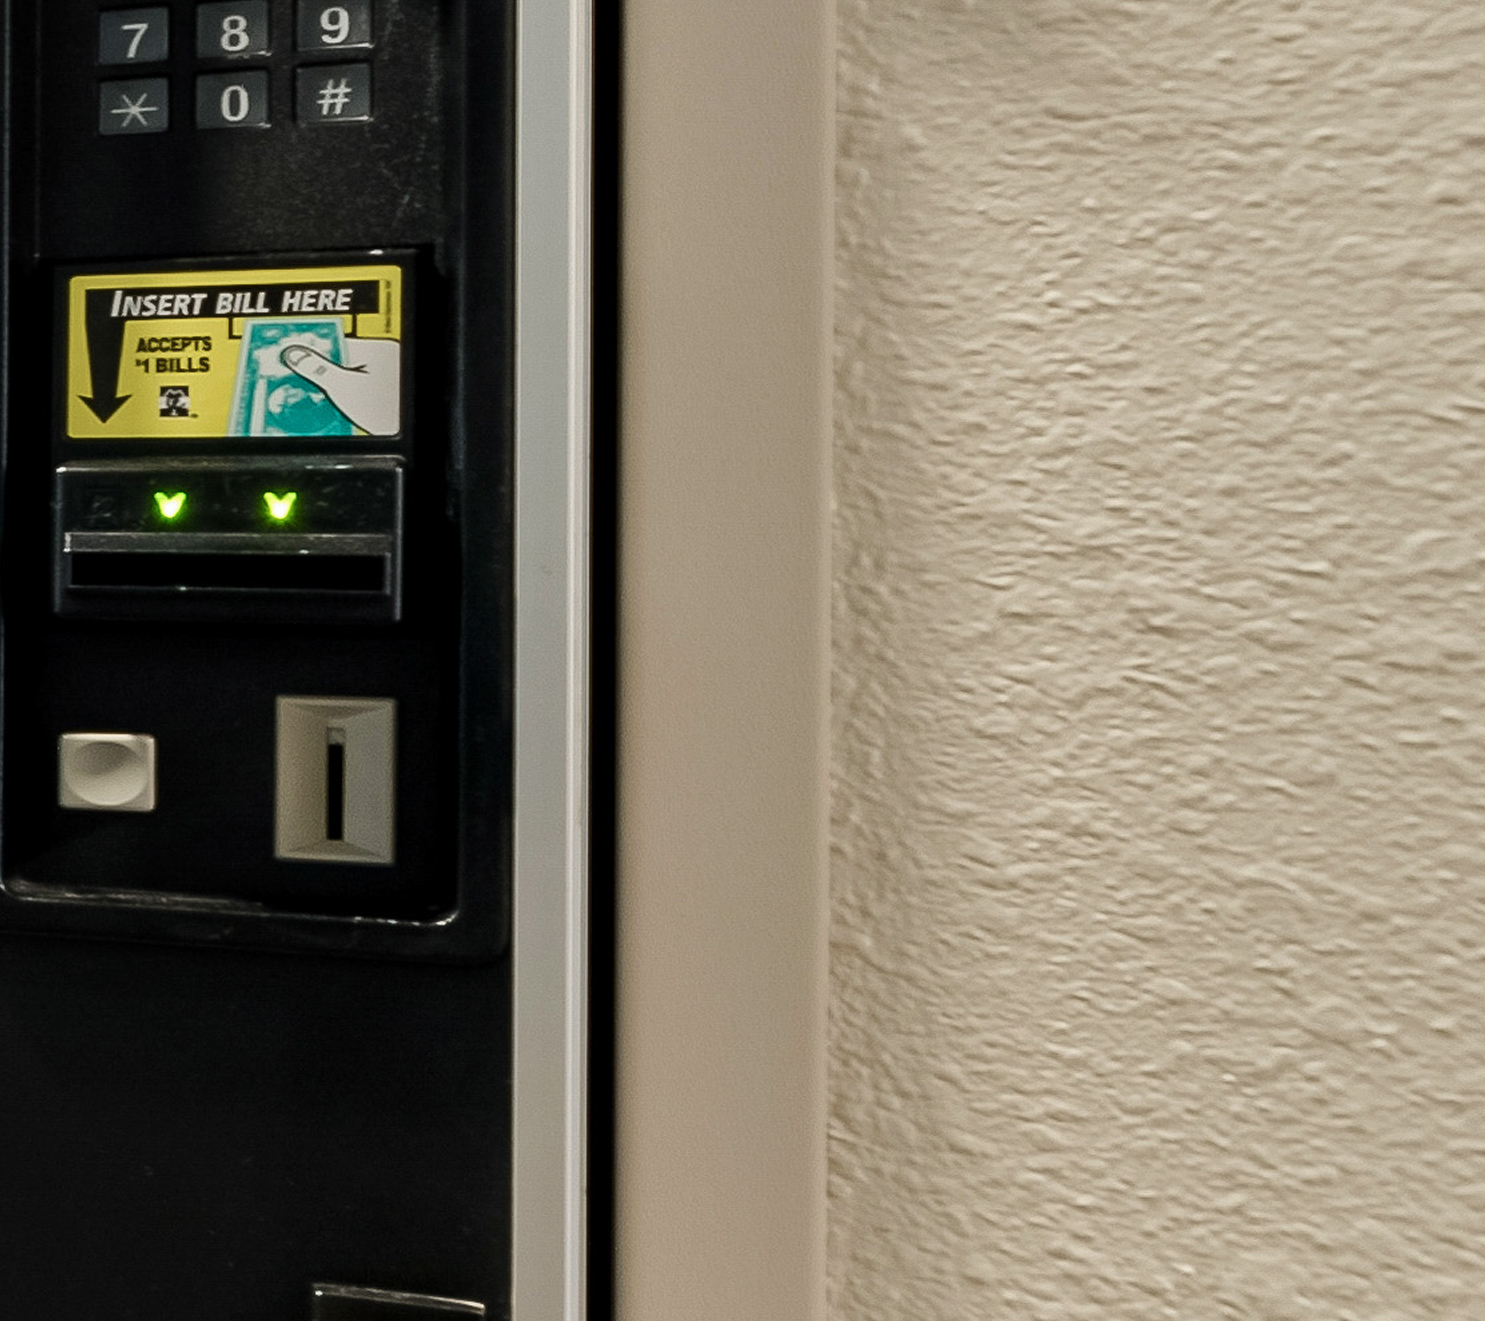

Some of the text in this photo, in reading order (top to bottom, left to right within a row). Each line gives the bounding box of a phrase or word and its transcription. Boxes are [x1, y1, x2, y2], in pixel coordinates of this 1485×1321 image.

[121, 6, 350, 58] 7 8 9
[221, 85, 249, 122] 0
[110, 288, 354, 318] INSERT BILL HERE
[135, 336, 212, 355] ACCEPTS
[155, 355, 210, 375] BILLS
